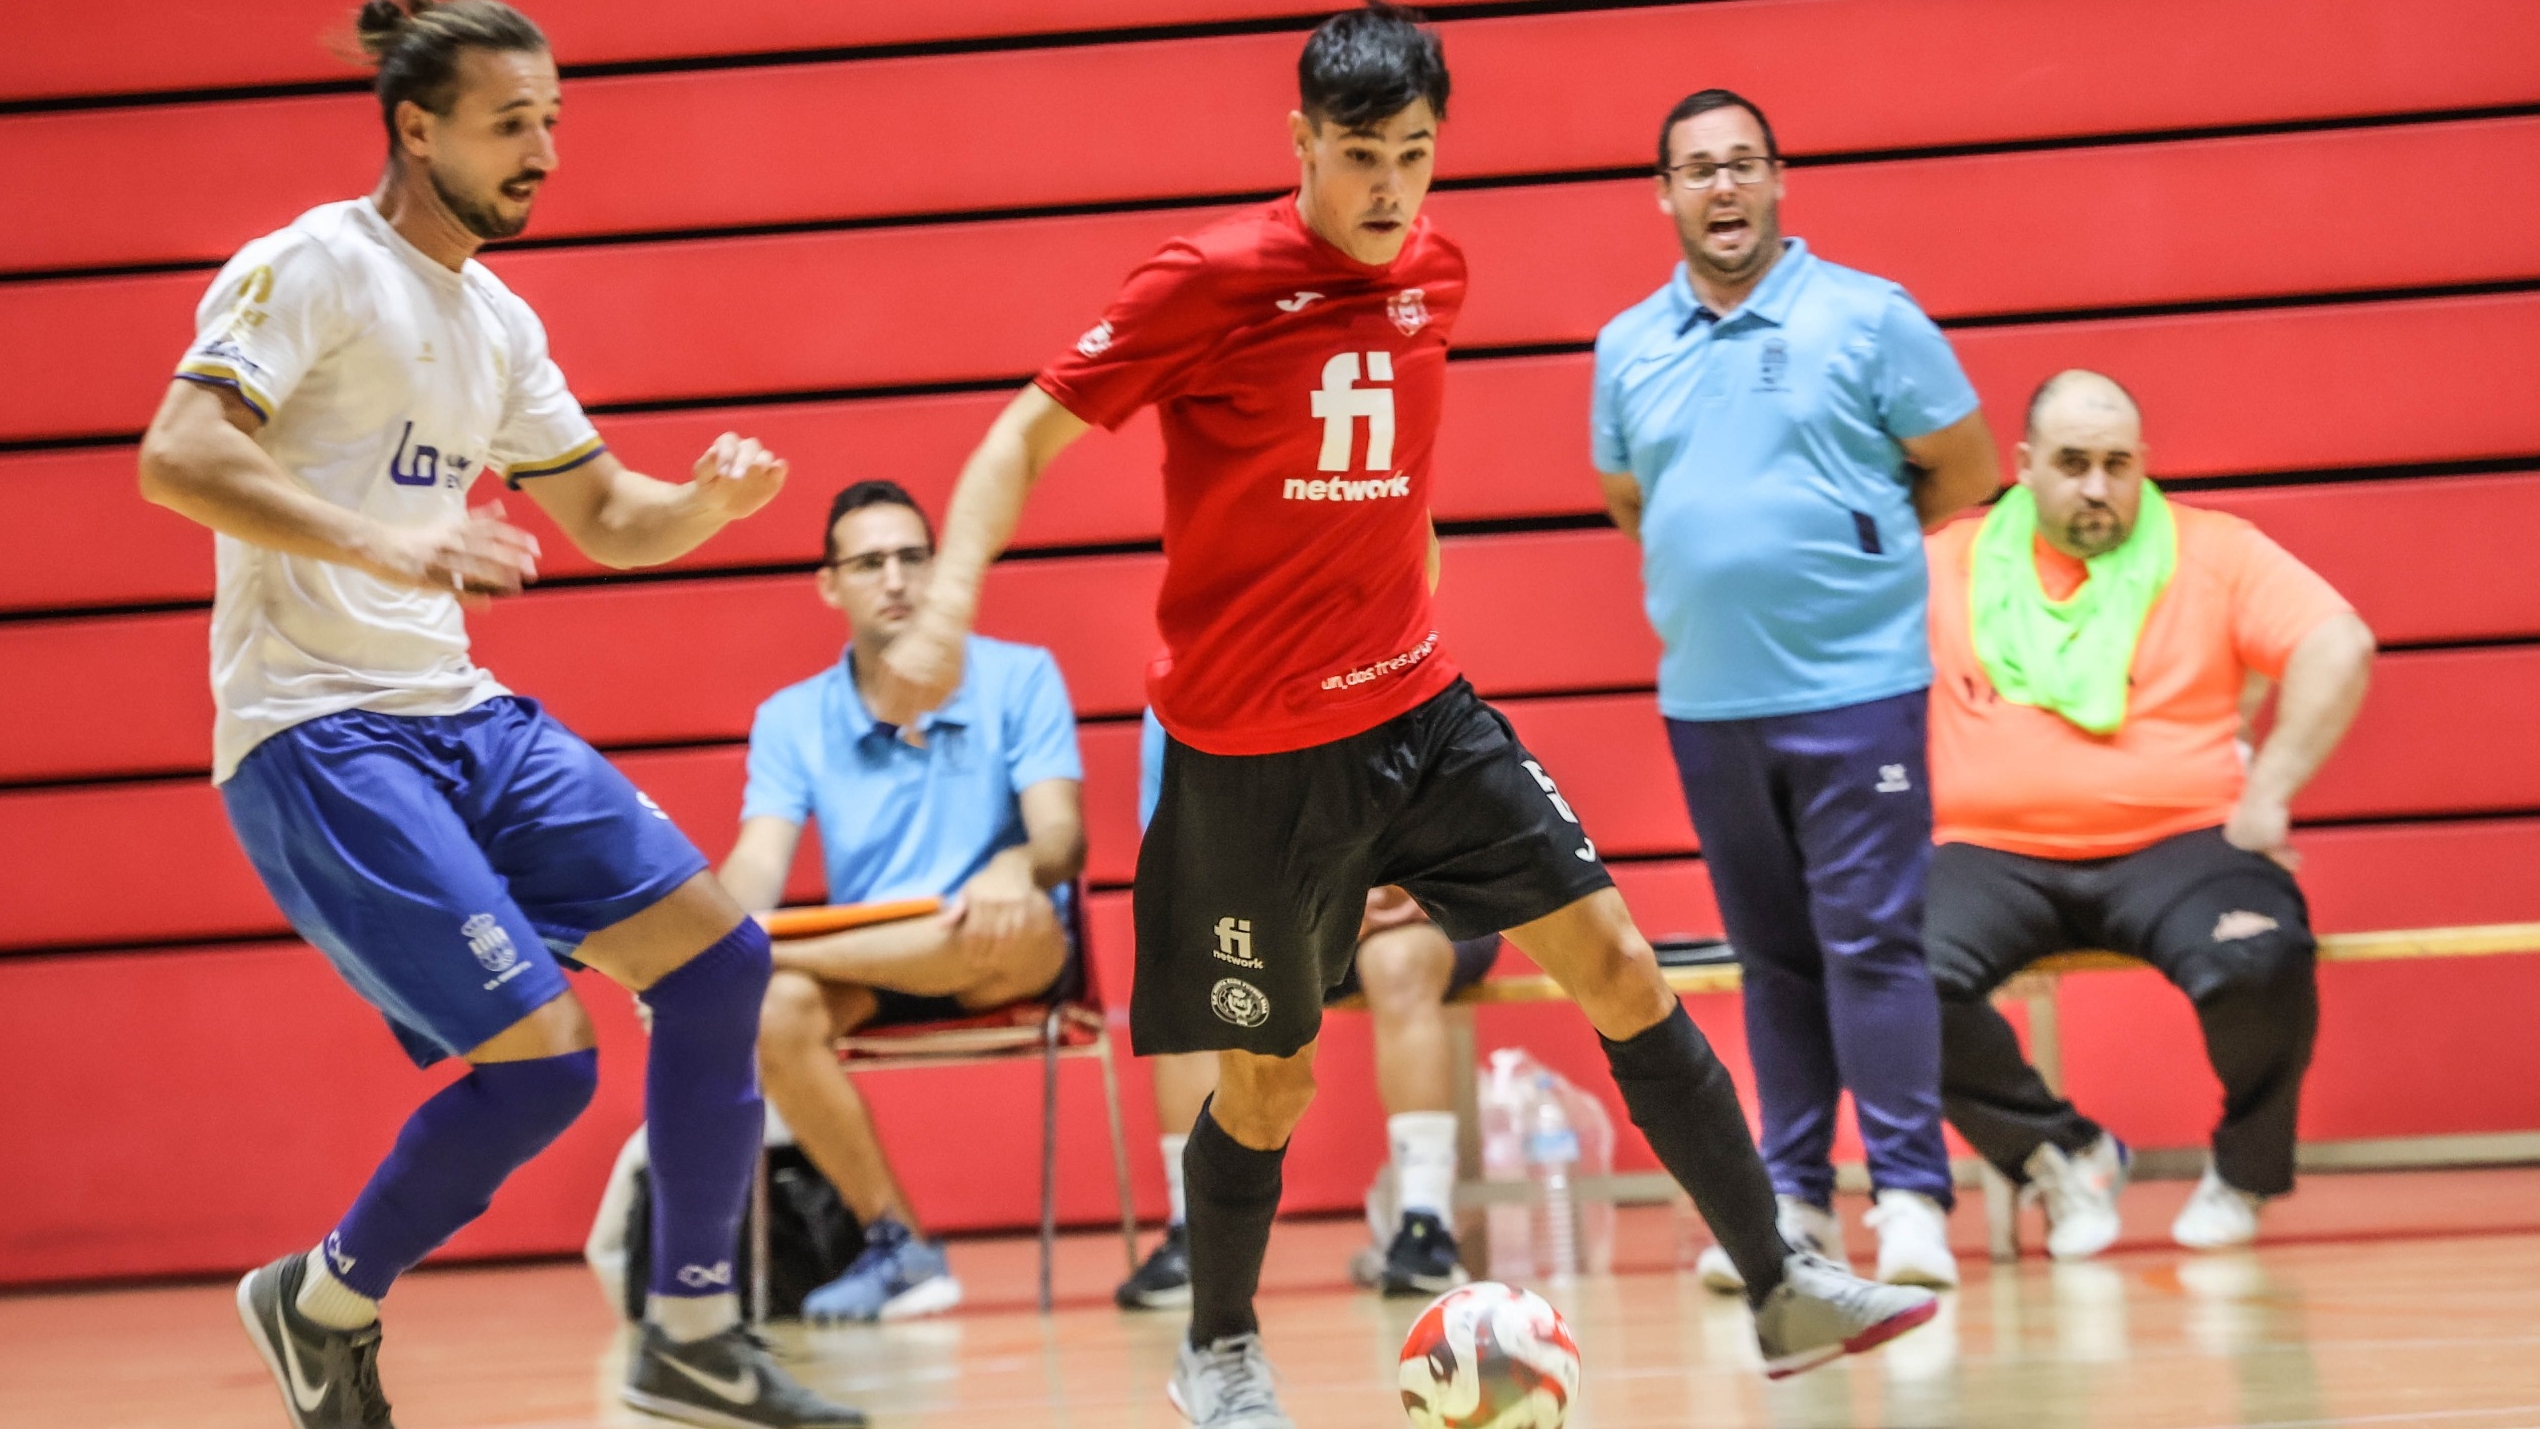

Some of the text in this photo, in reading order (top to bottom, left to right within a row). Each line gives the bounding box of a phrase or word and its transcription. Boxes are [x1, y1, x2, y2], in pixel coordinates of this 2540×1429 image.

[1310, 351, 1396, 472] fi
[1282, 470, 1410, 501] network
[1213, 916, 1251, 959] fi
[1212, 949, 1264, 969] network
